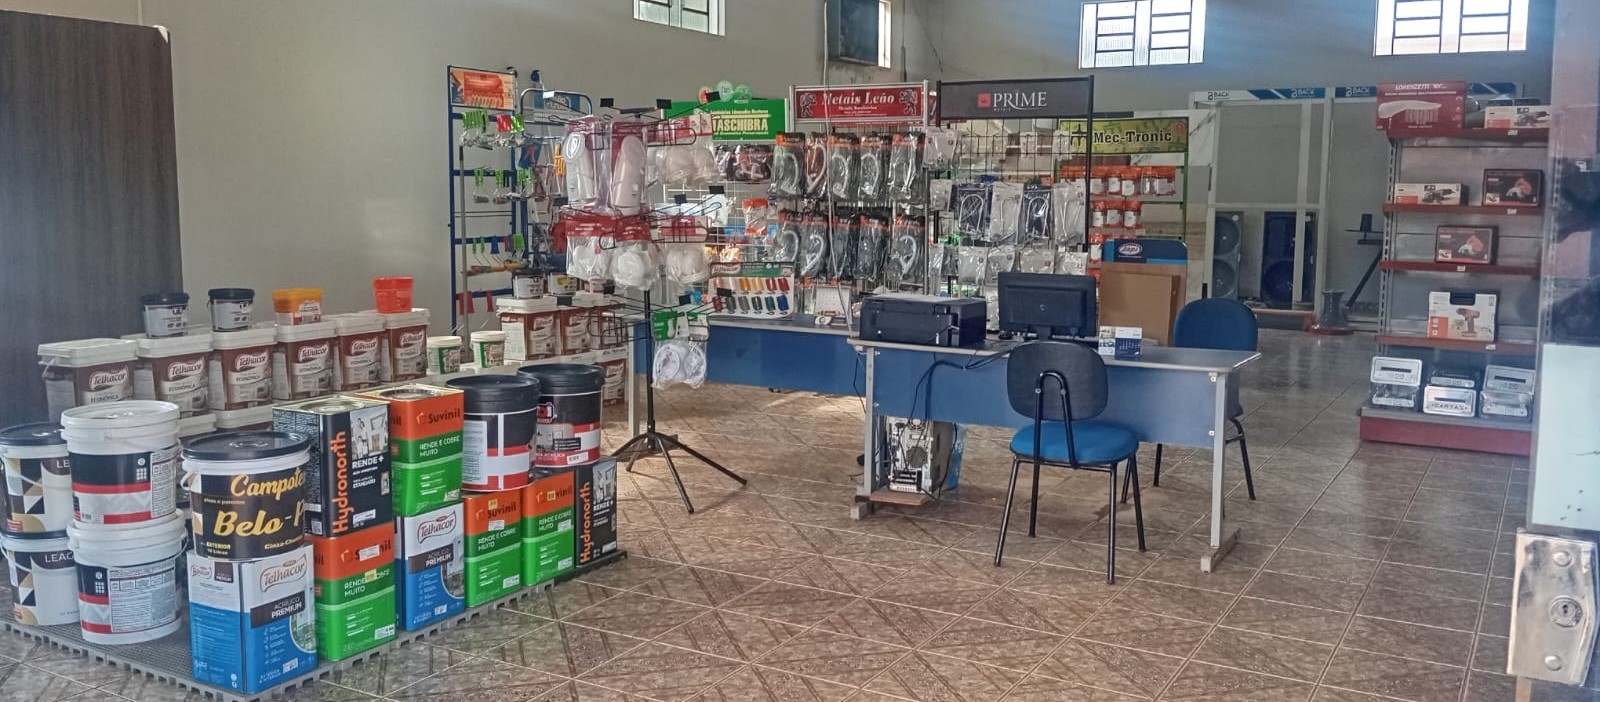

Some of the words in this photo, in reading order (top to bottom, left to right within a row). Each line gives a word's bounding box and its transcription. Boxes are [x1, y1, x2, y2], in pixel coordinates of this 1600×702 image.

[865, 91, 895, 105] Leão
[993, 91, 1047, 109] PRIME
[1093, 130, 1172, 144] Mec-Tronic
[240, 355, 266, 366] Telhacor
[172, 362, 202, 376] Telhacor
[94, 372, 126, 386] Telhacor
[428, 409, 460, 424] Suvinil
[330, 430, 354, 533] Hydronorth
[421, 520, 453, 537] Telhacor
[580, 481, 594, 563] Hydronorth
[264, 560, 305, 586] Telhacor
[344, 586, 366, 597] MUITO
[271, 603, 302, 618] PREMIUM
